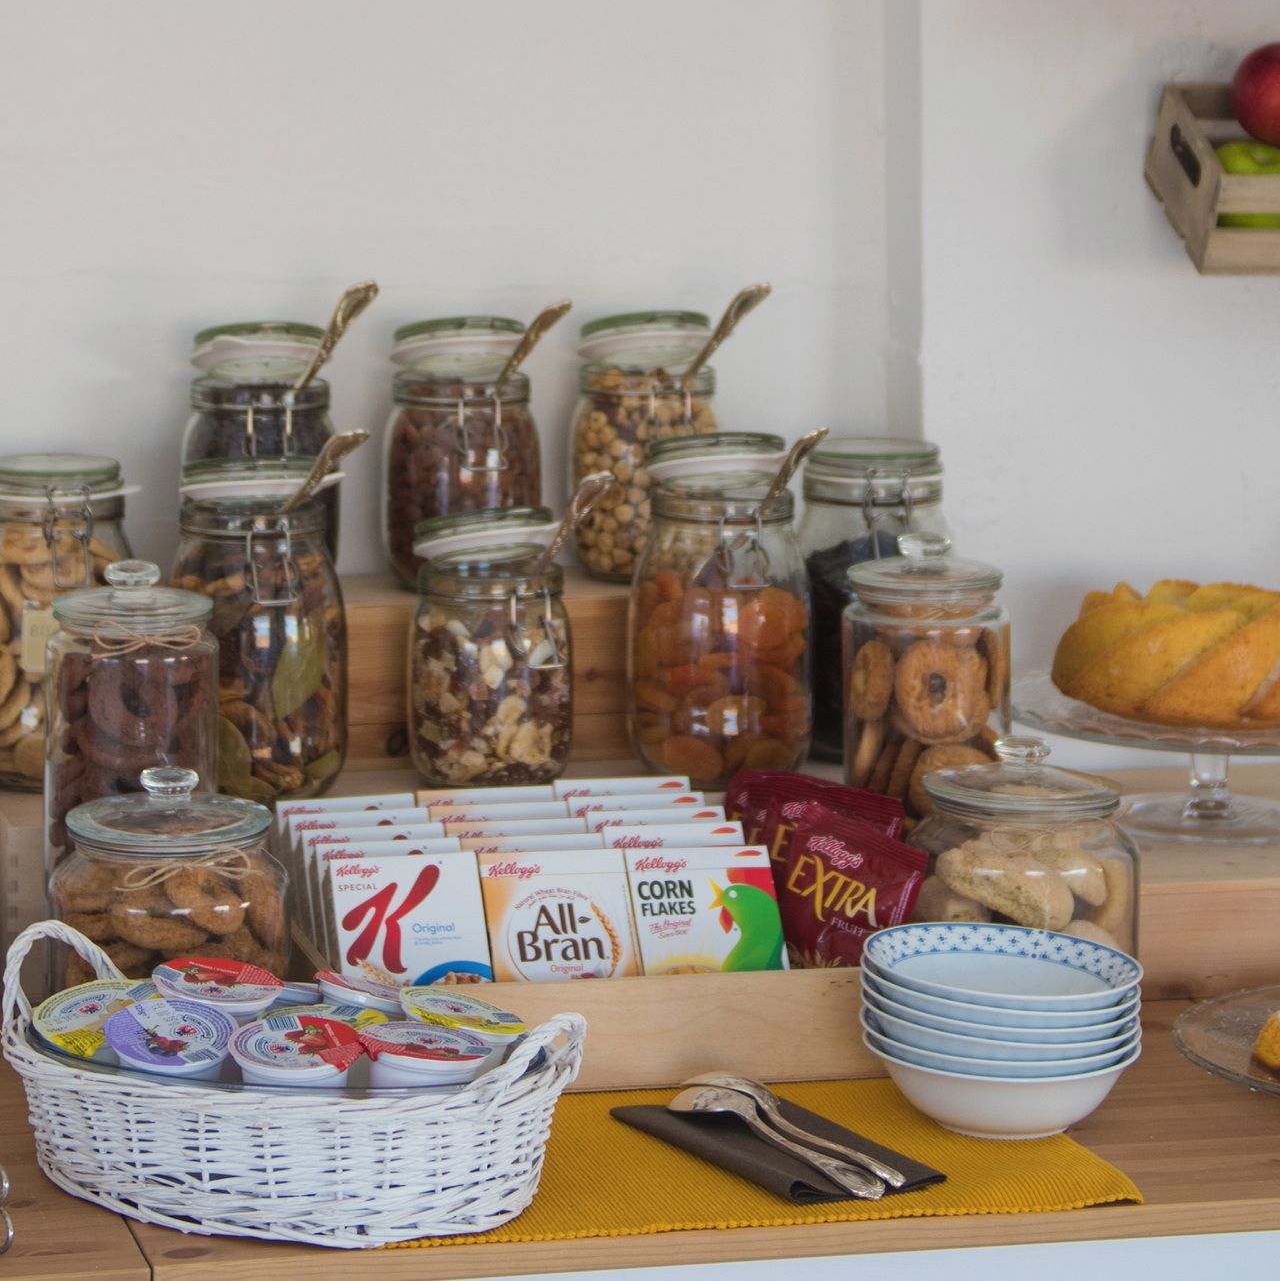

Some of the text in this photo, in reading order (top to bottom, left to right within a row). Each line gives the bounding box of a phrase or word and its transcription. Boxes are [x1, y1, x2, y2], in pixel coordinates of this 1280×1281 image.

[807, 836, 863, 869] Kellogg's
[336, 863, 381, 878] Kellogg's
[488, 861, 542, 879] Kellogg's
[635, 857, 688, 873] Kellogg's
[338, 883, 378, 893] SPECIAL
[637, 879, 694, 901] CORN
[786, 854, 879, 928] EXTRA
[641, 901, 697, 917] FLAKES
[342, 864, 440, 974] K
[830, 917, 865, 937] FRUIT
[411, 922, 456, 935] Original
[517, 931, 606, 963] Bran
[550, 964, 584, 974] Original
